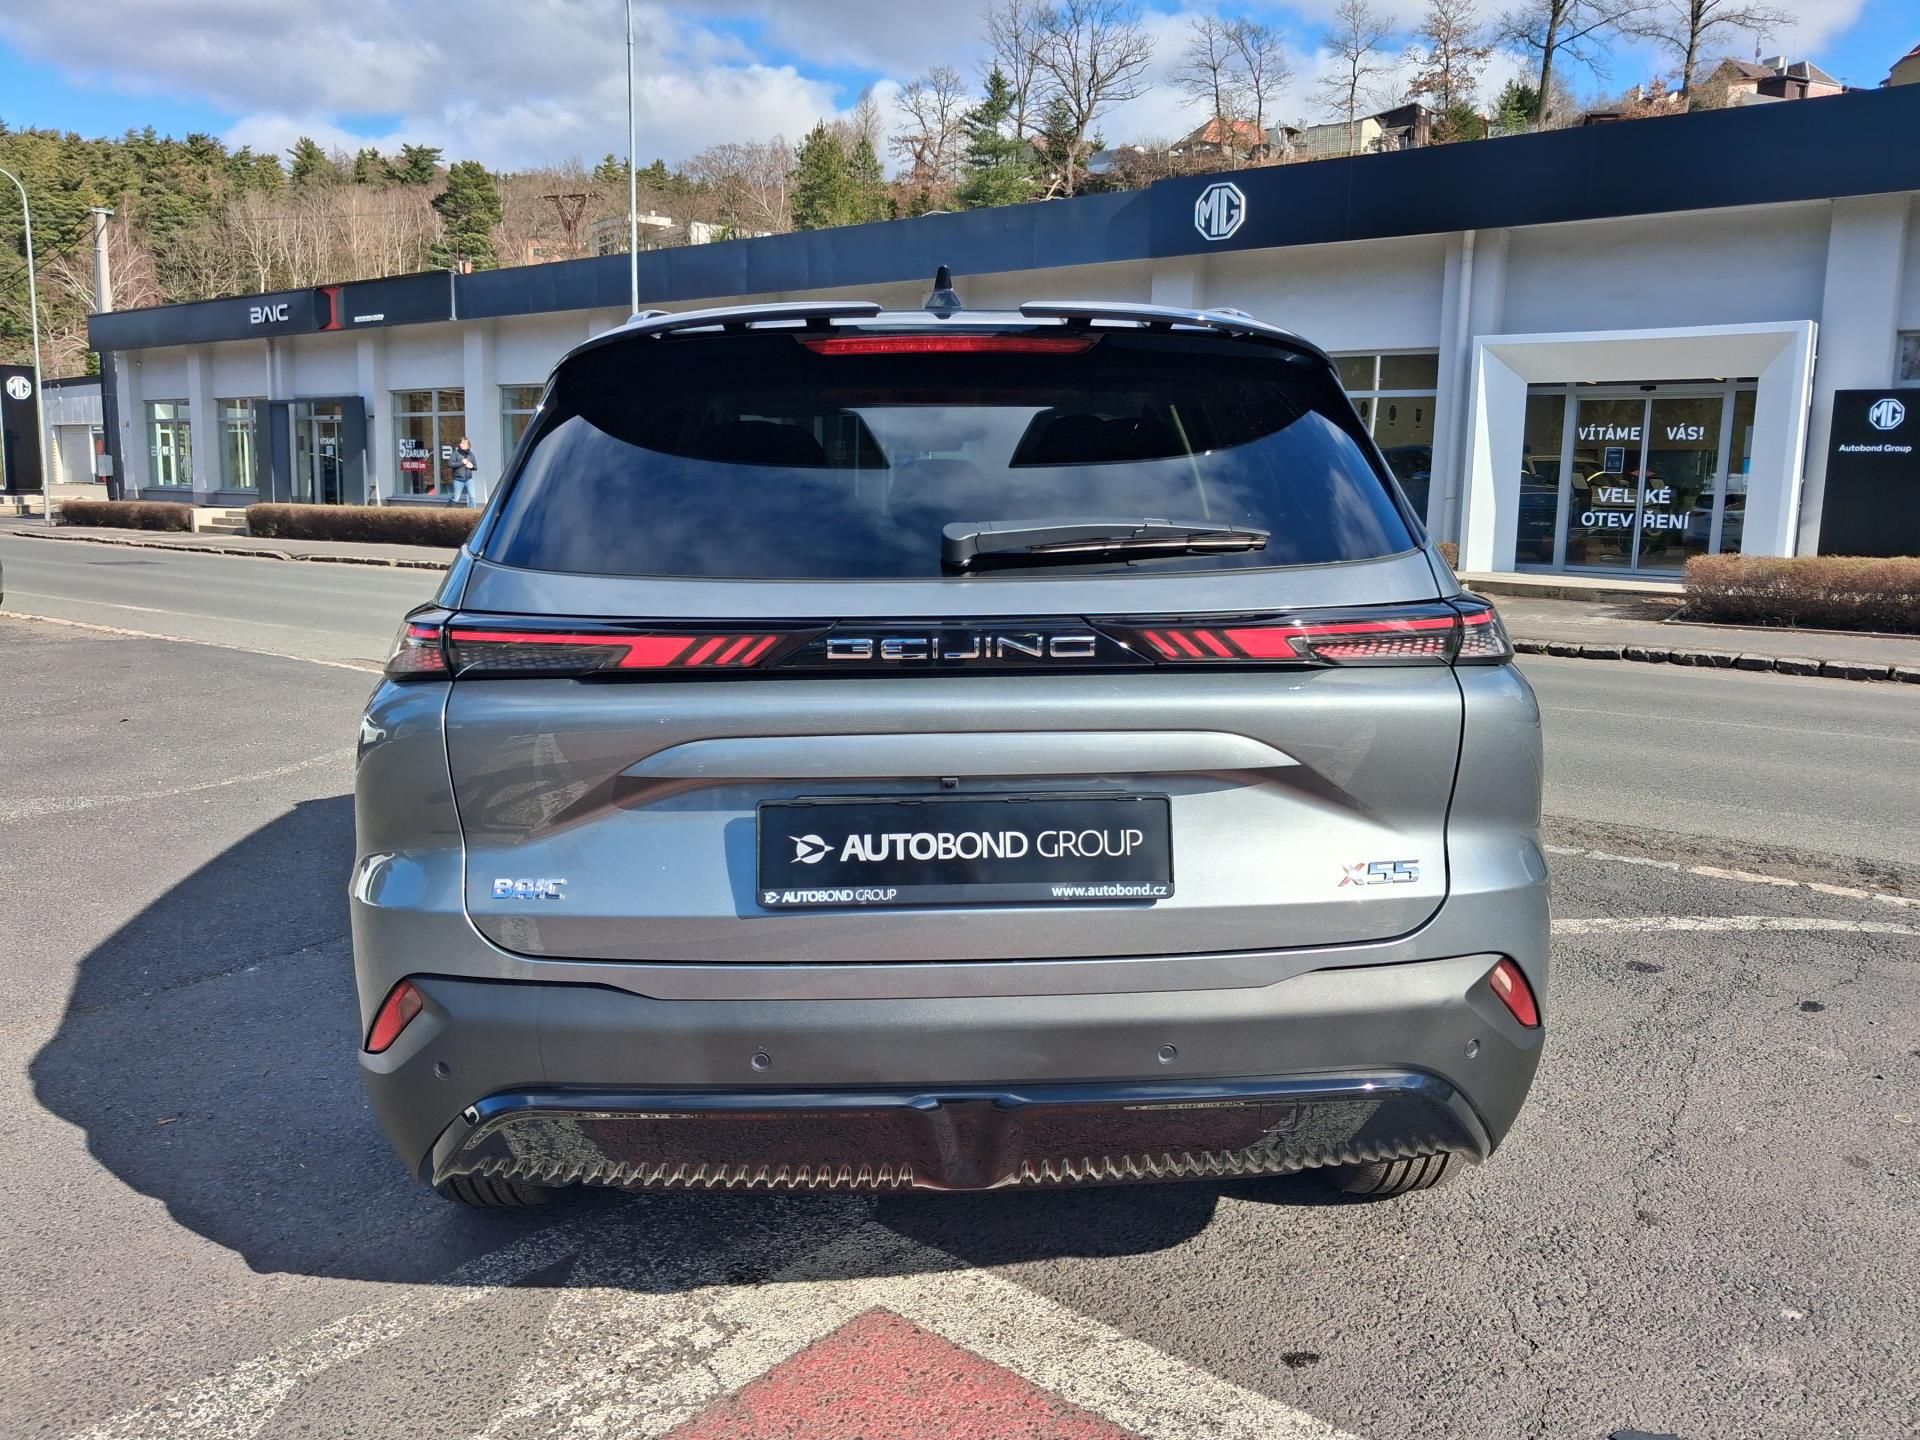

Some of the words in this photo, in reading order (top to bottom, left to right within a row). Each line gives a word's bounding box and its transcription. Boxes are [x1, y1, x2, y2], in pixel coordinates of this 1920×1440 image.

[1199, 187, 1240, 235] MG
[250, 303, 289, 324] BAIC
[9, 378, 30, 398] MG
[1872, 401, 1902, 427] MG
[1578, 423, 1641, 440] VÍTÁME
[1666, 422, 1705, 440] VÁS!
[399, 438, 406, 458] 5
[1839, 444, 1882, 452] Autobond
[1884, 444, 1912, 453] Group
[1581, 510, 1690, 530] OTEVŘENÍ
[840, 831, 1028, 862] AUTOBOND
[1037, 829, 1144, 858] GROUP
[1337, 859, 1420, 887] X55
[492, 878, 567, 900] BAIC
[782, 890, 854, 903] AUTOBOND
[855, 888, 897, 902] GROUP
[1051, 883, 1168, 898] www.autobond.cz
